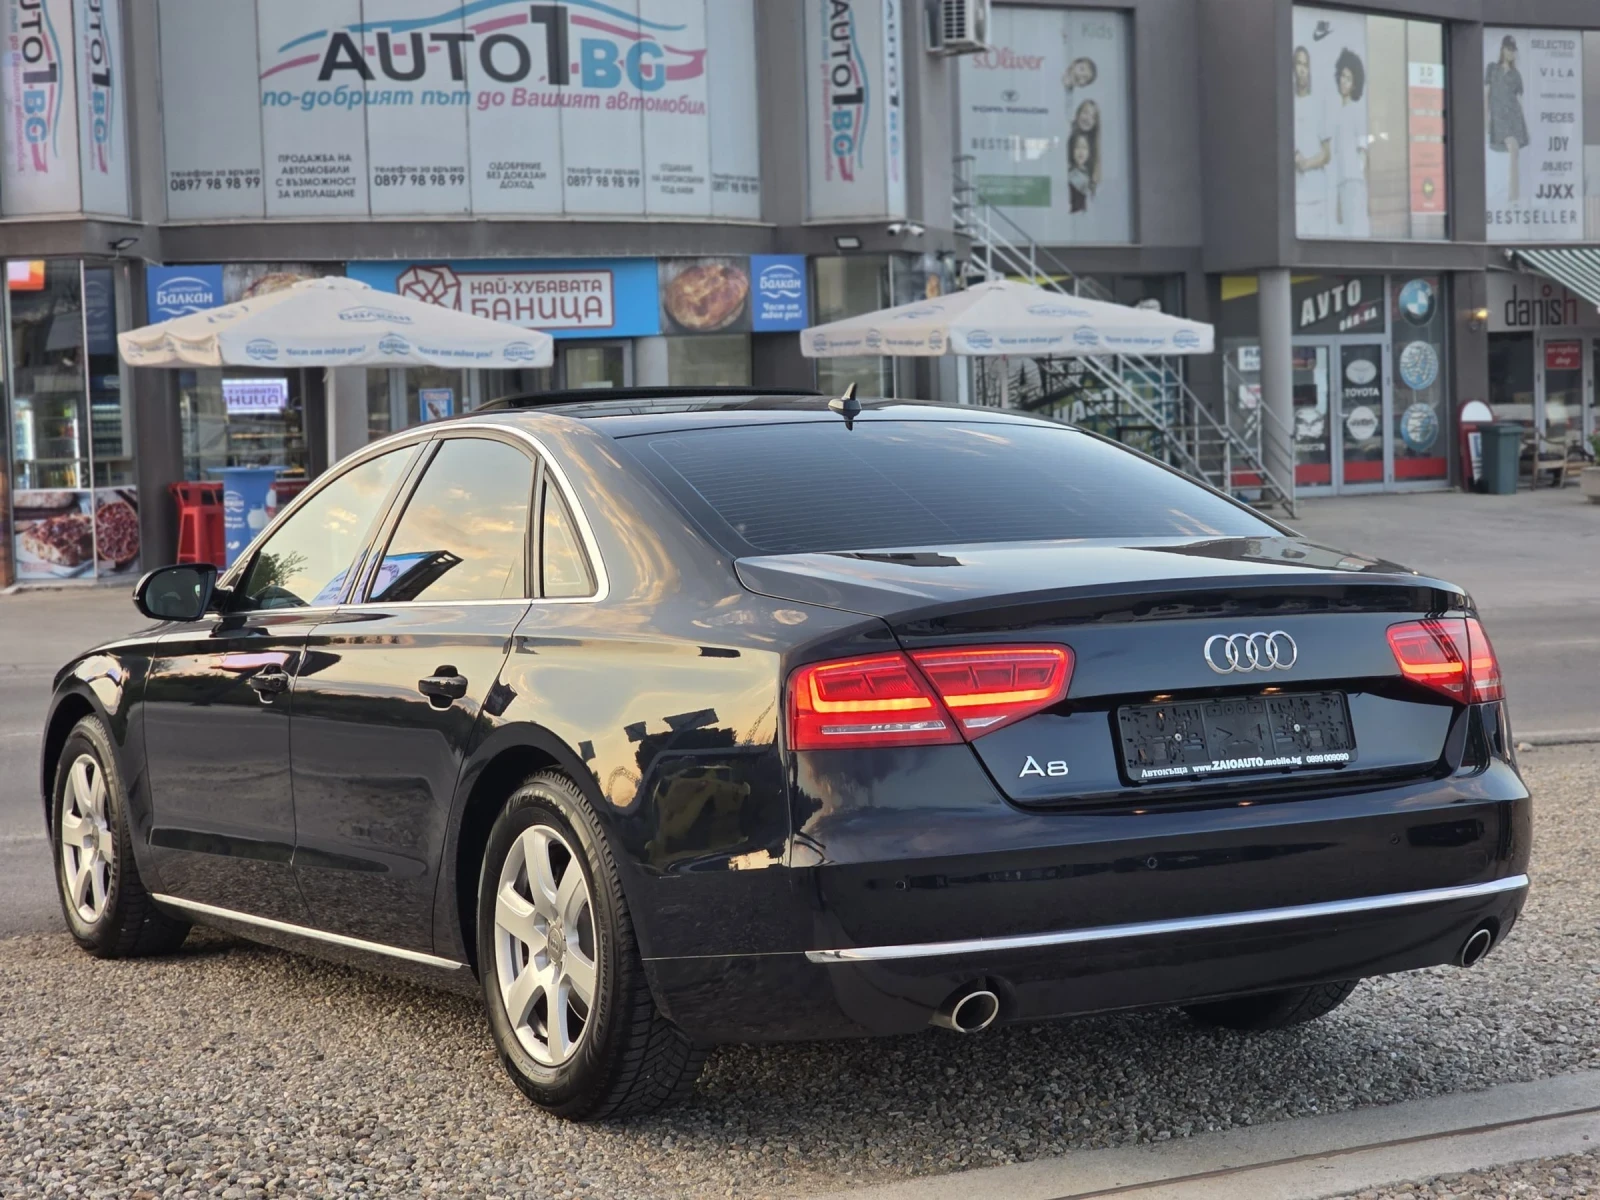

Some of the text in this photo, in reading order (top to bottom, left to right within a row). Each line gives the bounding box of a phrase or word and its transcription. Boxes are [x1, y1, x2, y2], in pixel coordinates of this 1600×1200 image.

[1531, 39, 1576, 50] SELECTED
[1540, 67, 1575, 77] VILA
[262, 85, 706, 115] по-добрият път до Вашият автомобил
[1540, 111, 1576, 123] PIECES
[1548, 136, 1569, 152] JDY
[278, 153, 352, 163] ПРОДАЖБА НА
[281, 165, 350, 175] АВТОМОБИЛИ
[489, 161, 541, 170] ОДОБРЕНИЕ
[275, 177, 356, 187] С ВЪЗМОЖНОСТ
[374, 174, 465, 186] 0897 98 98 99
[486, 171, 547, 180] БЕЗ ДОКАЗАН
[567, 175, 640, 188] 0897 98 98 99
[170, 177, 260, 191] 0897 98 98 99
[499, 180, 535, 189] ДОХОД
[278, 189, 355, 199] ЗА ИЗПЛАЩАНЕ
[1535, 184, 1575, 199] JJXX
[1486, 209, 1577, 225] BESTSELLER
[470, 278, 602, 295] НАЙ-ХУБАВАТА
[760, 276, 801, 289] Балкан
[156, 291, 214, 306] Балкан
[471, 296, 603, 323] БАНИЦА
[1505, 284, 1578, 327] danish
[1344, 387, 1379, 397] TOYOTA
[1019, 755, 1069, 779] A8
[1141, 765, 1188, 779] Автокъща
[600, 933, 609, 991] Control
